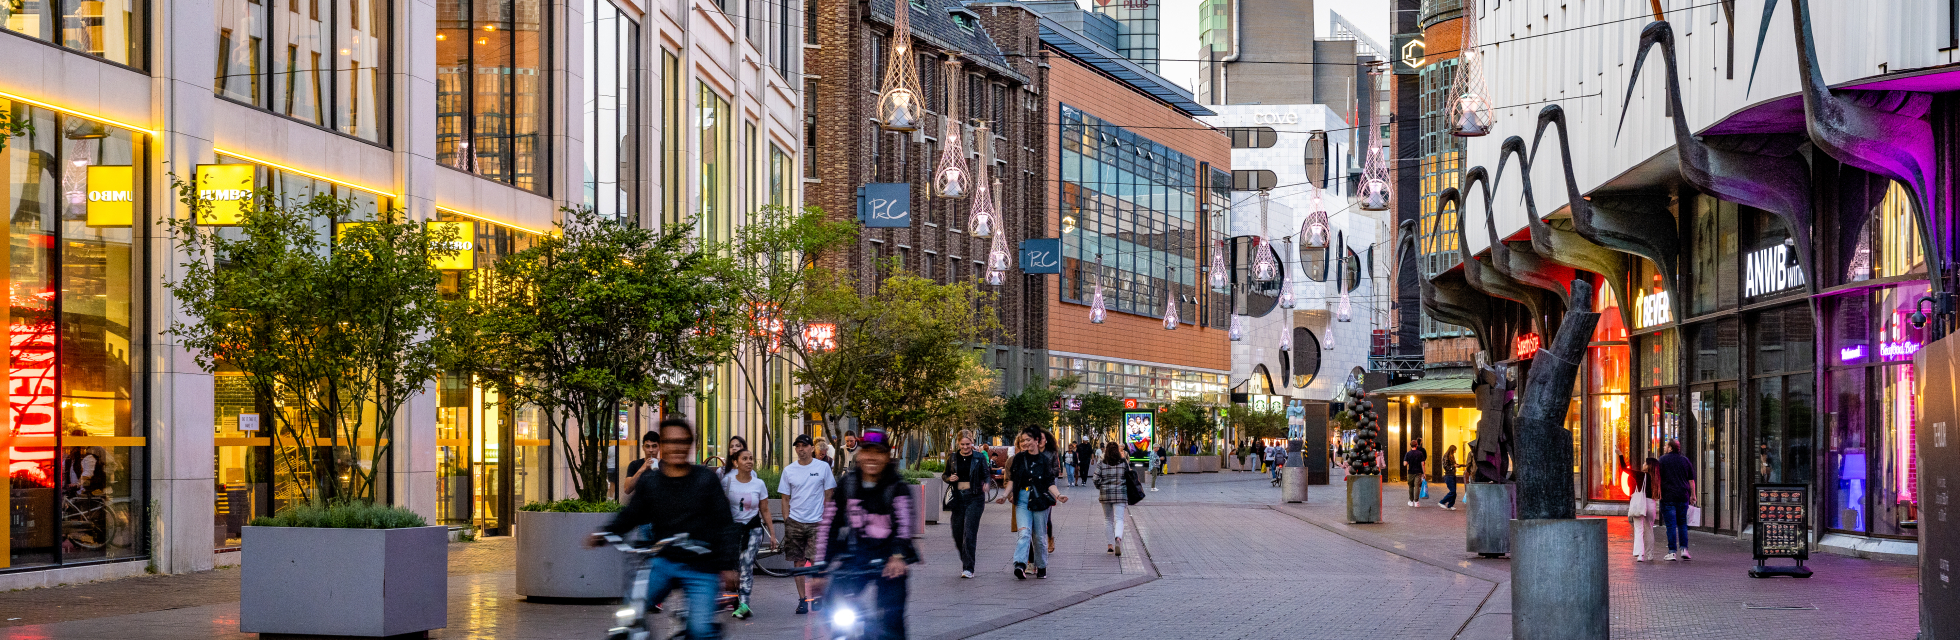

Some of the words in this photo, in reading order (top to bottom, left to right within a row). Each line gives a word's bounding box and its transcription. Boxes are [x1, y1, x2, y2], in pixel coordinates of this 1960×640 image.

[1253, 112, 1298, 125] cove
[198, 189, 253, 202] JUMBO
[1745, 243, 1787, 298] ANWB
[1643, 290, 1670, 327] BEVER
